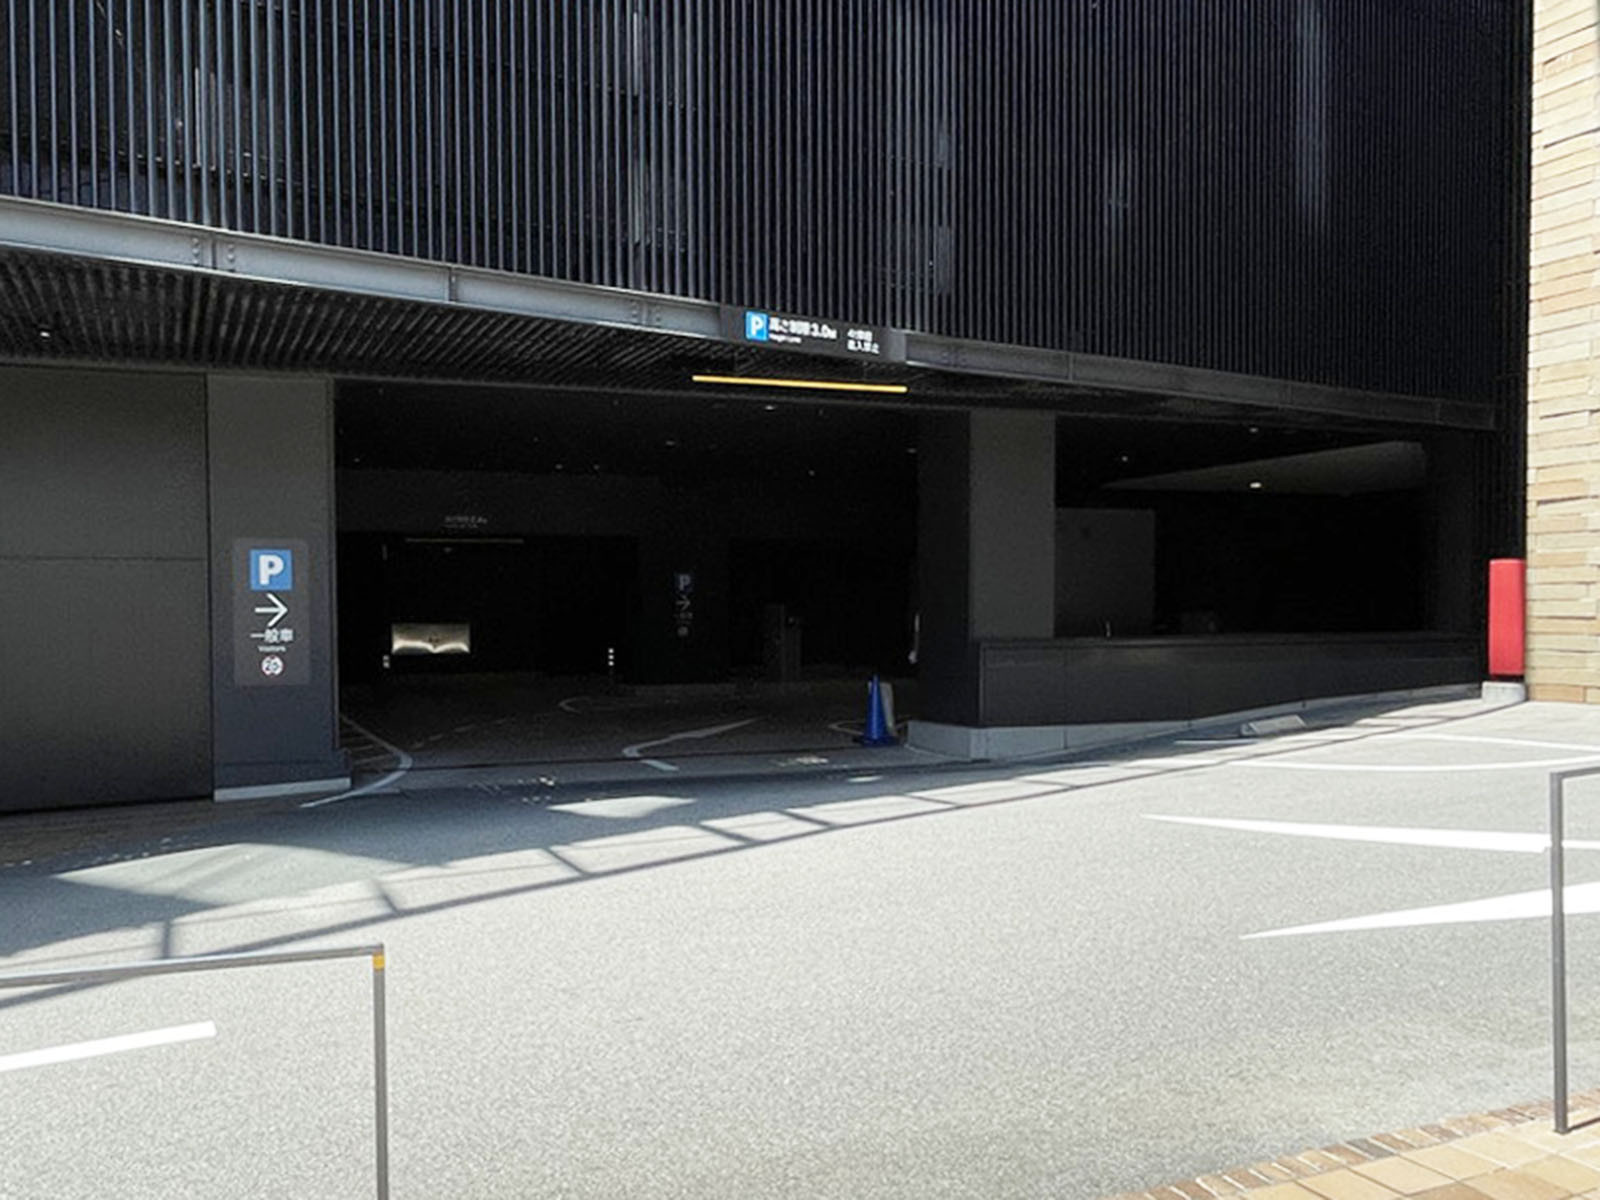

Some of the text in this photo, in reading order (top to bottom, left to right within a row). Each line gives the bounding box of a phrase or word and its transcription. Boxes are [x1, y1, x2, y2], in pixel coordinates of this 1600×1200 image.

[751, 314, 764, 336] P
[259, 554, 284, 585] P
[250, 628, 293, 643] 一般車
